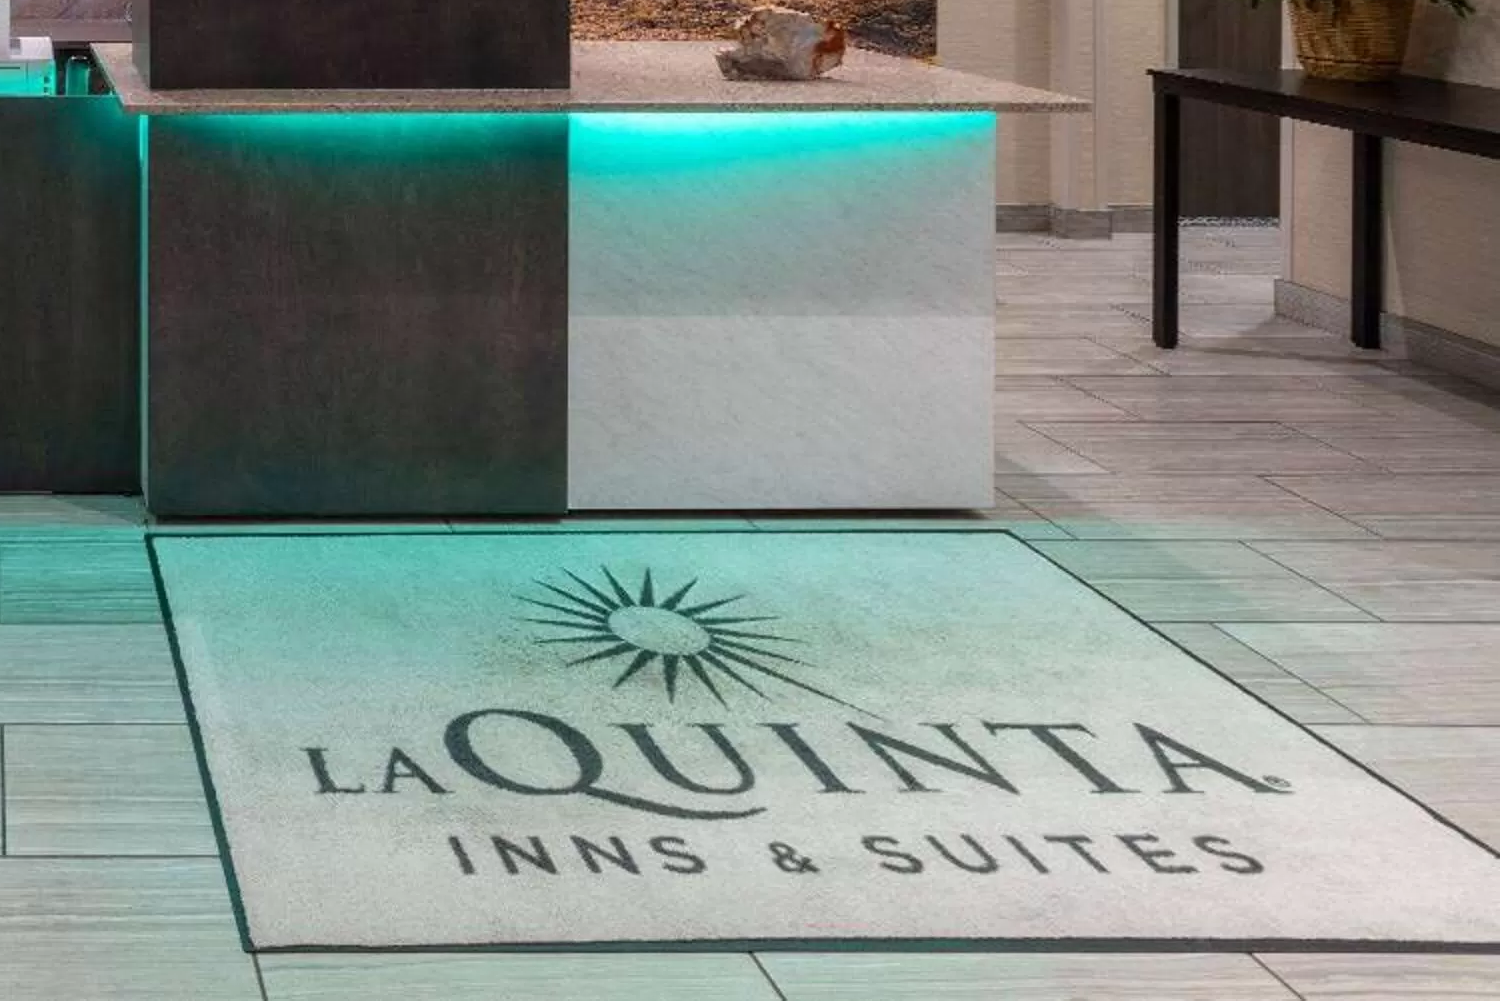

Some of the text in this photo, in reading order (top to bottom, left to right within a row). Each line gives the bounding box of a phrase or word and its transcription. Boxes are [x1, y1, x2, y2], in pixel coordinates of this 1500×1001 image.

[303, 746, 453, 796] LA
[447, 834, 1265, 876] INNS & SUITES
